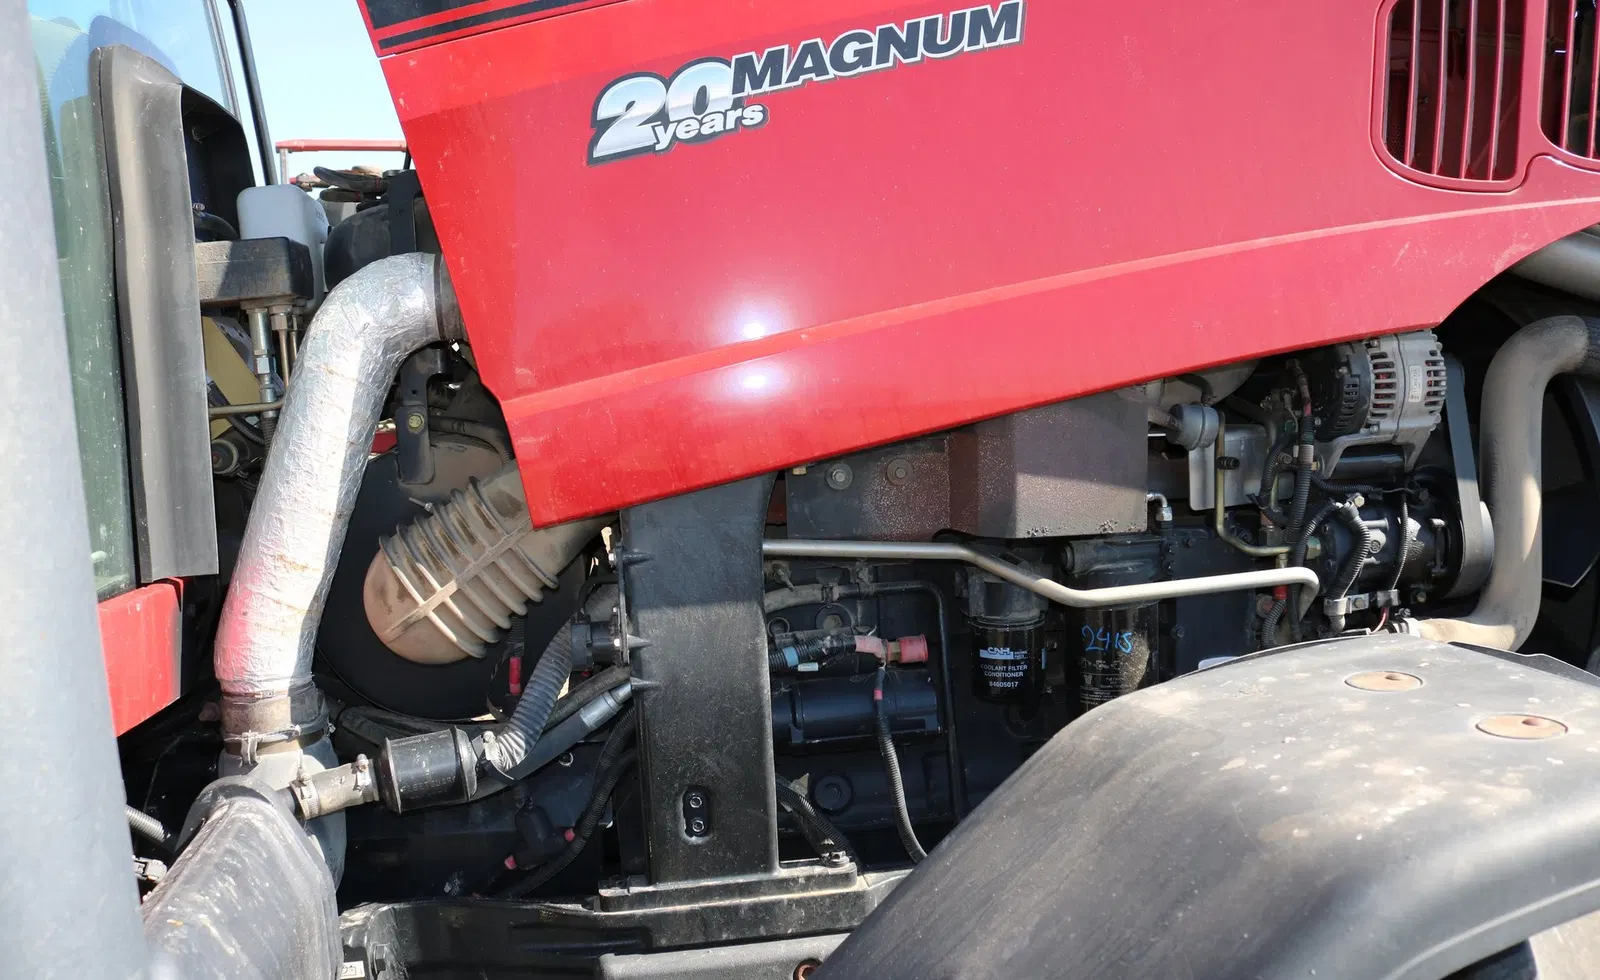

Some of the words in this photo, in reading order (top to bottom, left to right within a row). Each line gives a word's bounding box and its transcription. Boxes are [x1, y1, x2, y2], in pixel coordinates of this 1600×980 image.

[732, 1, 1022, 97] MAGNUM
[592, 61, 734, 158] 20
[654, 103, 764, 151] years
[987, 647, 1010, 656] CNH
